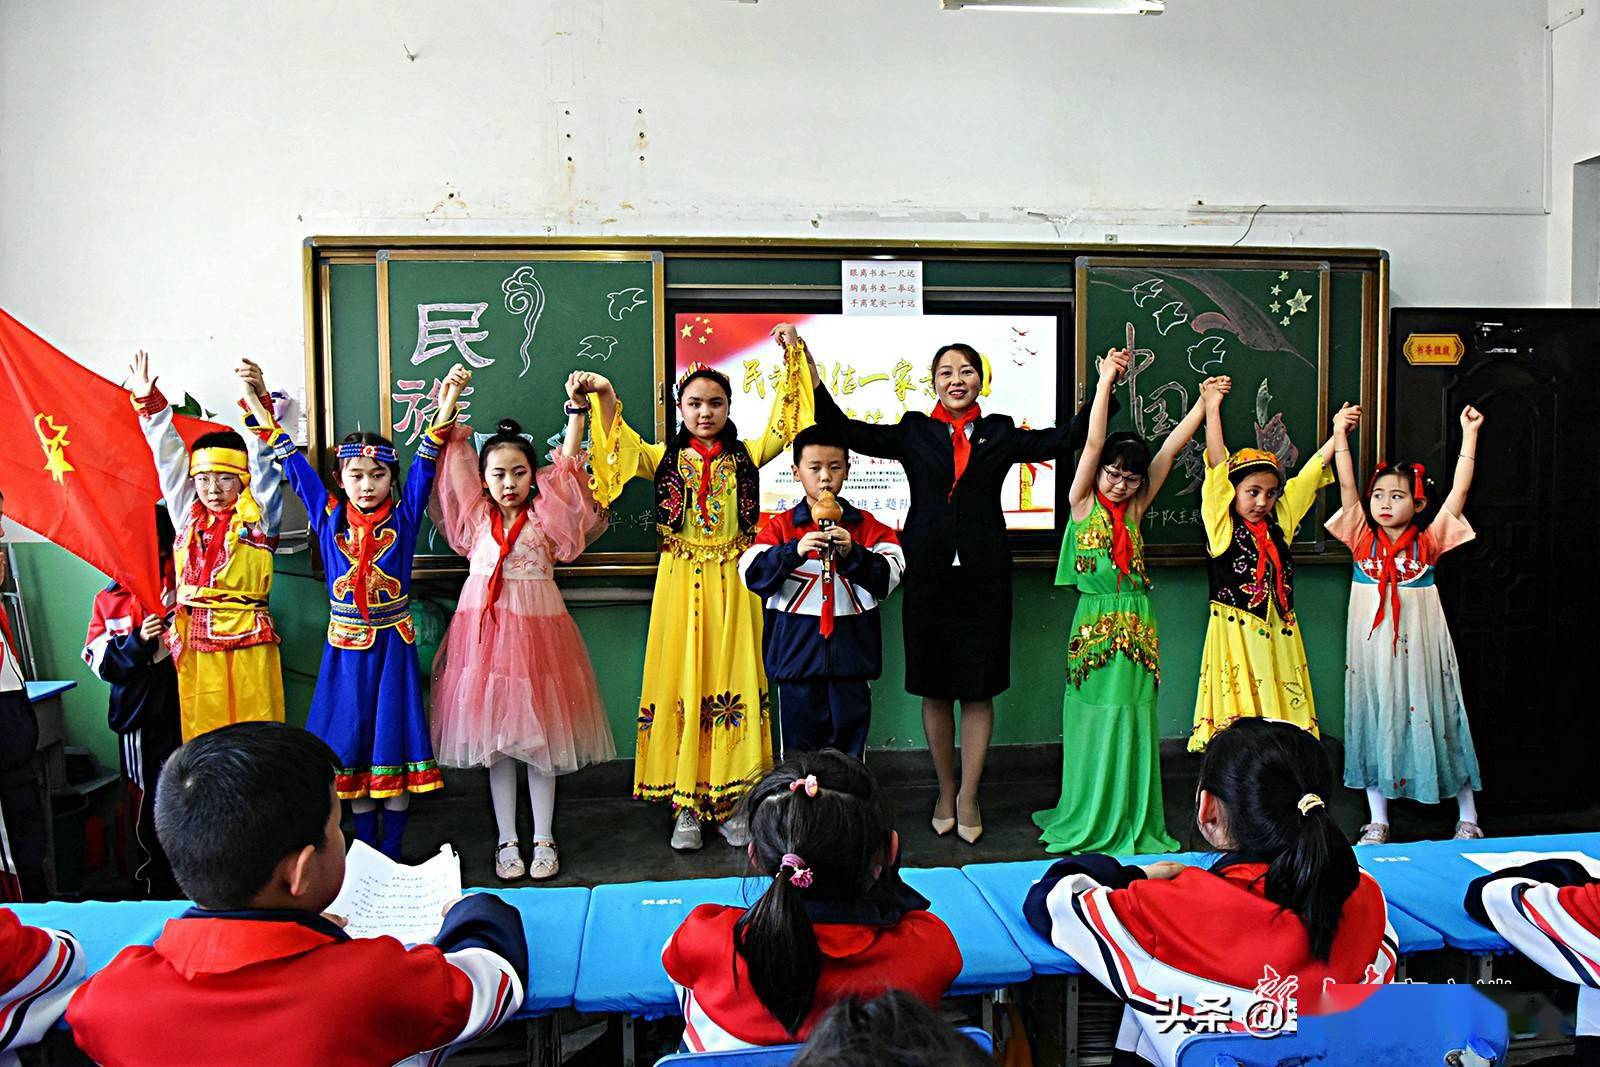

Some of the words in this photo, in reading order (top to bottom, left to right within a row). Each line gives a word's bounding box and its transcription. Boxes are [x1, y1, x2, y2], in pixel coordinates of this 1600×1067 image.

[850, 268, 916, 278] 眼离书本一尺远
[850, 283, 916, 293] 胸离书桌一拳远
